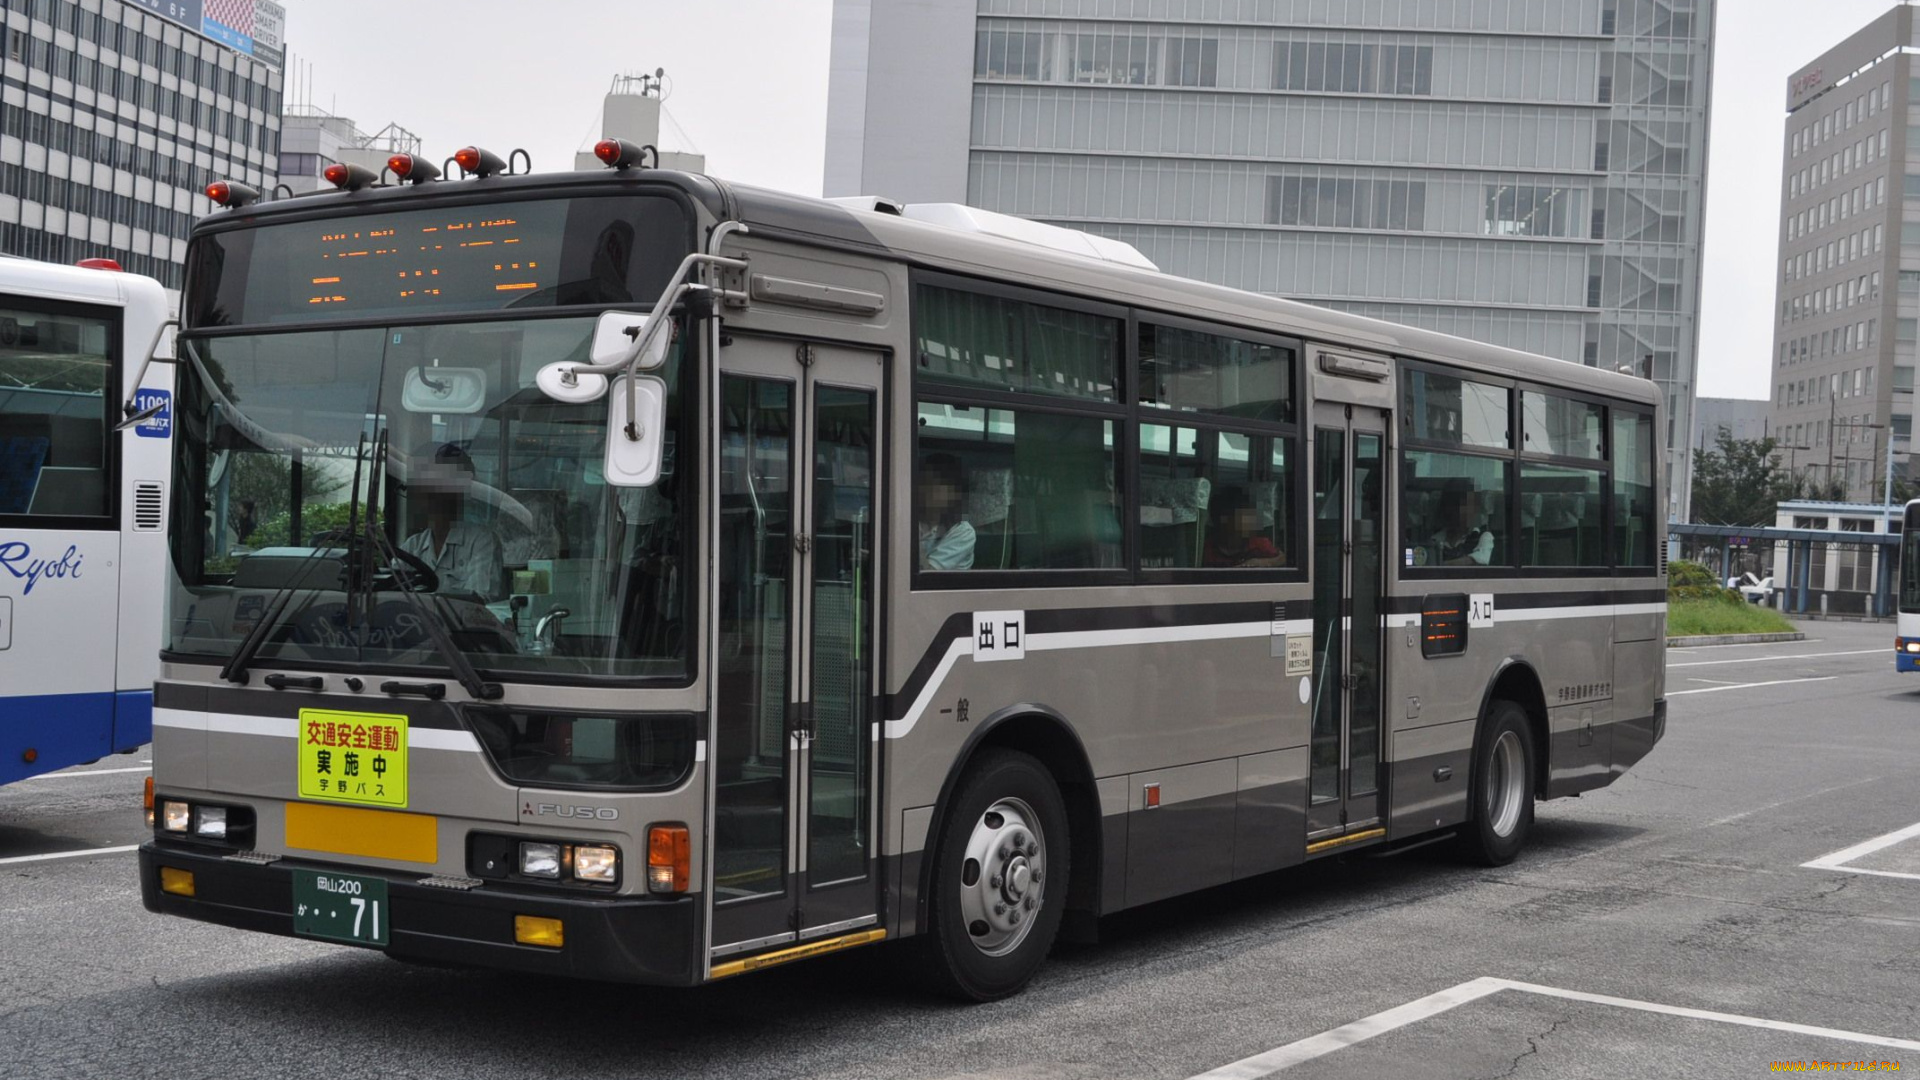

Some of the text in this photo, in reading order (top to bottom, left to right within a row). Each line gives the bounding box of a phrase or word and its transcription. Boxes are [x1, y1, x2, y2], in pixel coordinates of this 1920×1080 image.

[254, 12, 277, 33] SMART
[254, 26, 278, 47] DRIVER
[0, 541, 84, 596] Ryobi
[1472, 601, 1492, 620] 入口
[978, 620, 1020, 651] 出口
[940, 697, 970, 722] 一般
[307, 720, 399, 752] 交通安全運動
[317, 749, 387, 779] 実施中
[319, 779, 385, 797] 宇野バス
[537, 802, 619, 821] FUSO
